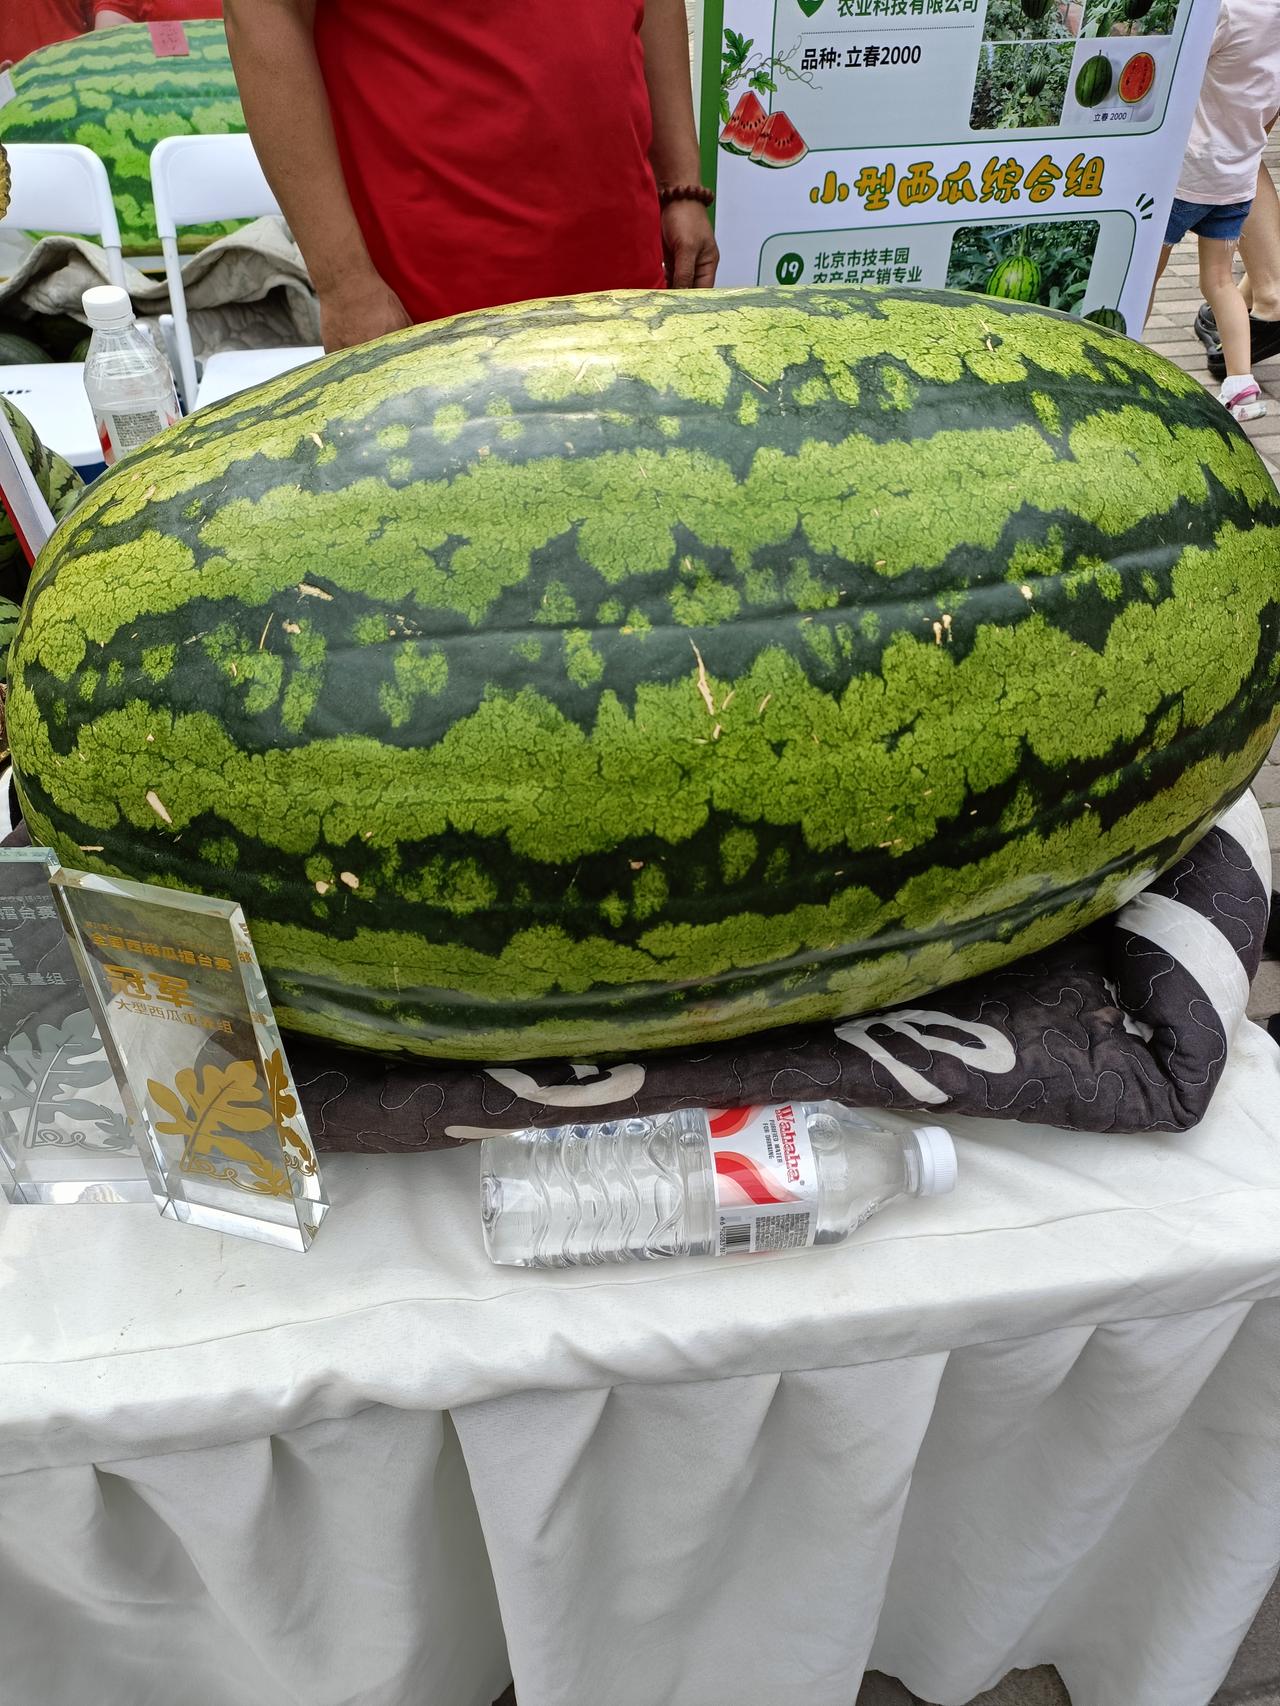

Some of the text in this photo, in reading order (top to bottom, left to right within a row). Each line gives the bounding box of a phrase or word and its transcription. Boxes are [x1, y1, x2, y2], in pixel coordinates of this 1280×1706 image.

[837, 0, 978, 17] 农业科技有限公司
[1110, 112, 1127, 121] 2000
[809, 152, 1105, 212] 小型西瓜综合组
[781, 261, 799, 279] 19
[814, 247, 910, 270] 北京市技丰园
[813, 266, 923, 285] 农产品产销专业
[103, 963, 196, 1008] 冠军
[769, 1119, 783, 1163] PURIFIED WATER
[775, 1105, 801, 1183] Wahaha
